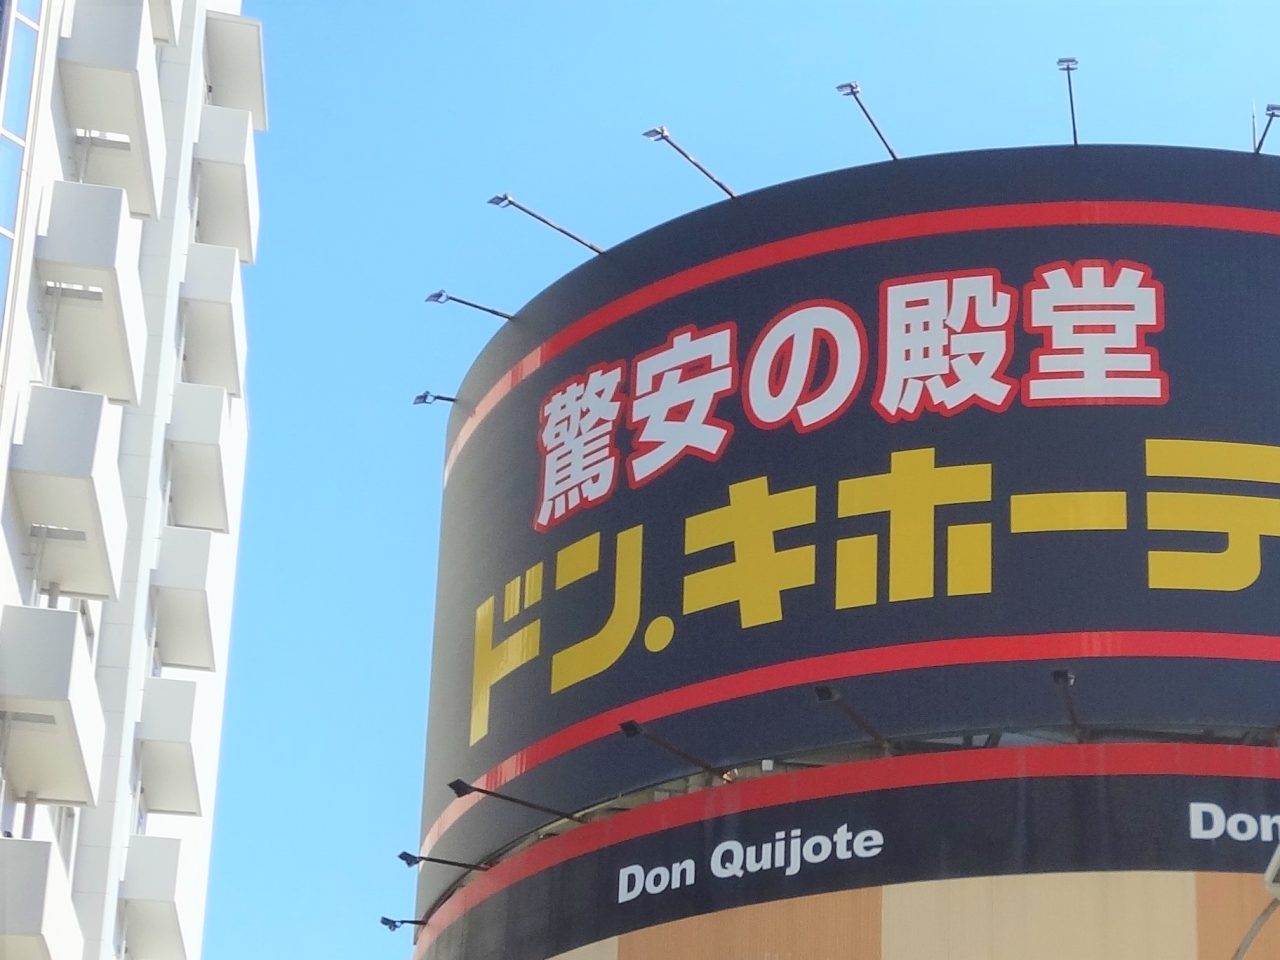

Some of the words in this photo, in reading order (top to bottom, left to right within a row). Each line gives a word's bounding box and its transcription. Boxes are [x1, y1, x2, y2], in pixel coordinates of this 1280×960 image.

[535, 261, 1167, 530] 驚安の殿堂
[618, 858, 696, 903] Don
[710, 823, 884, 878] Quijote
